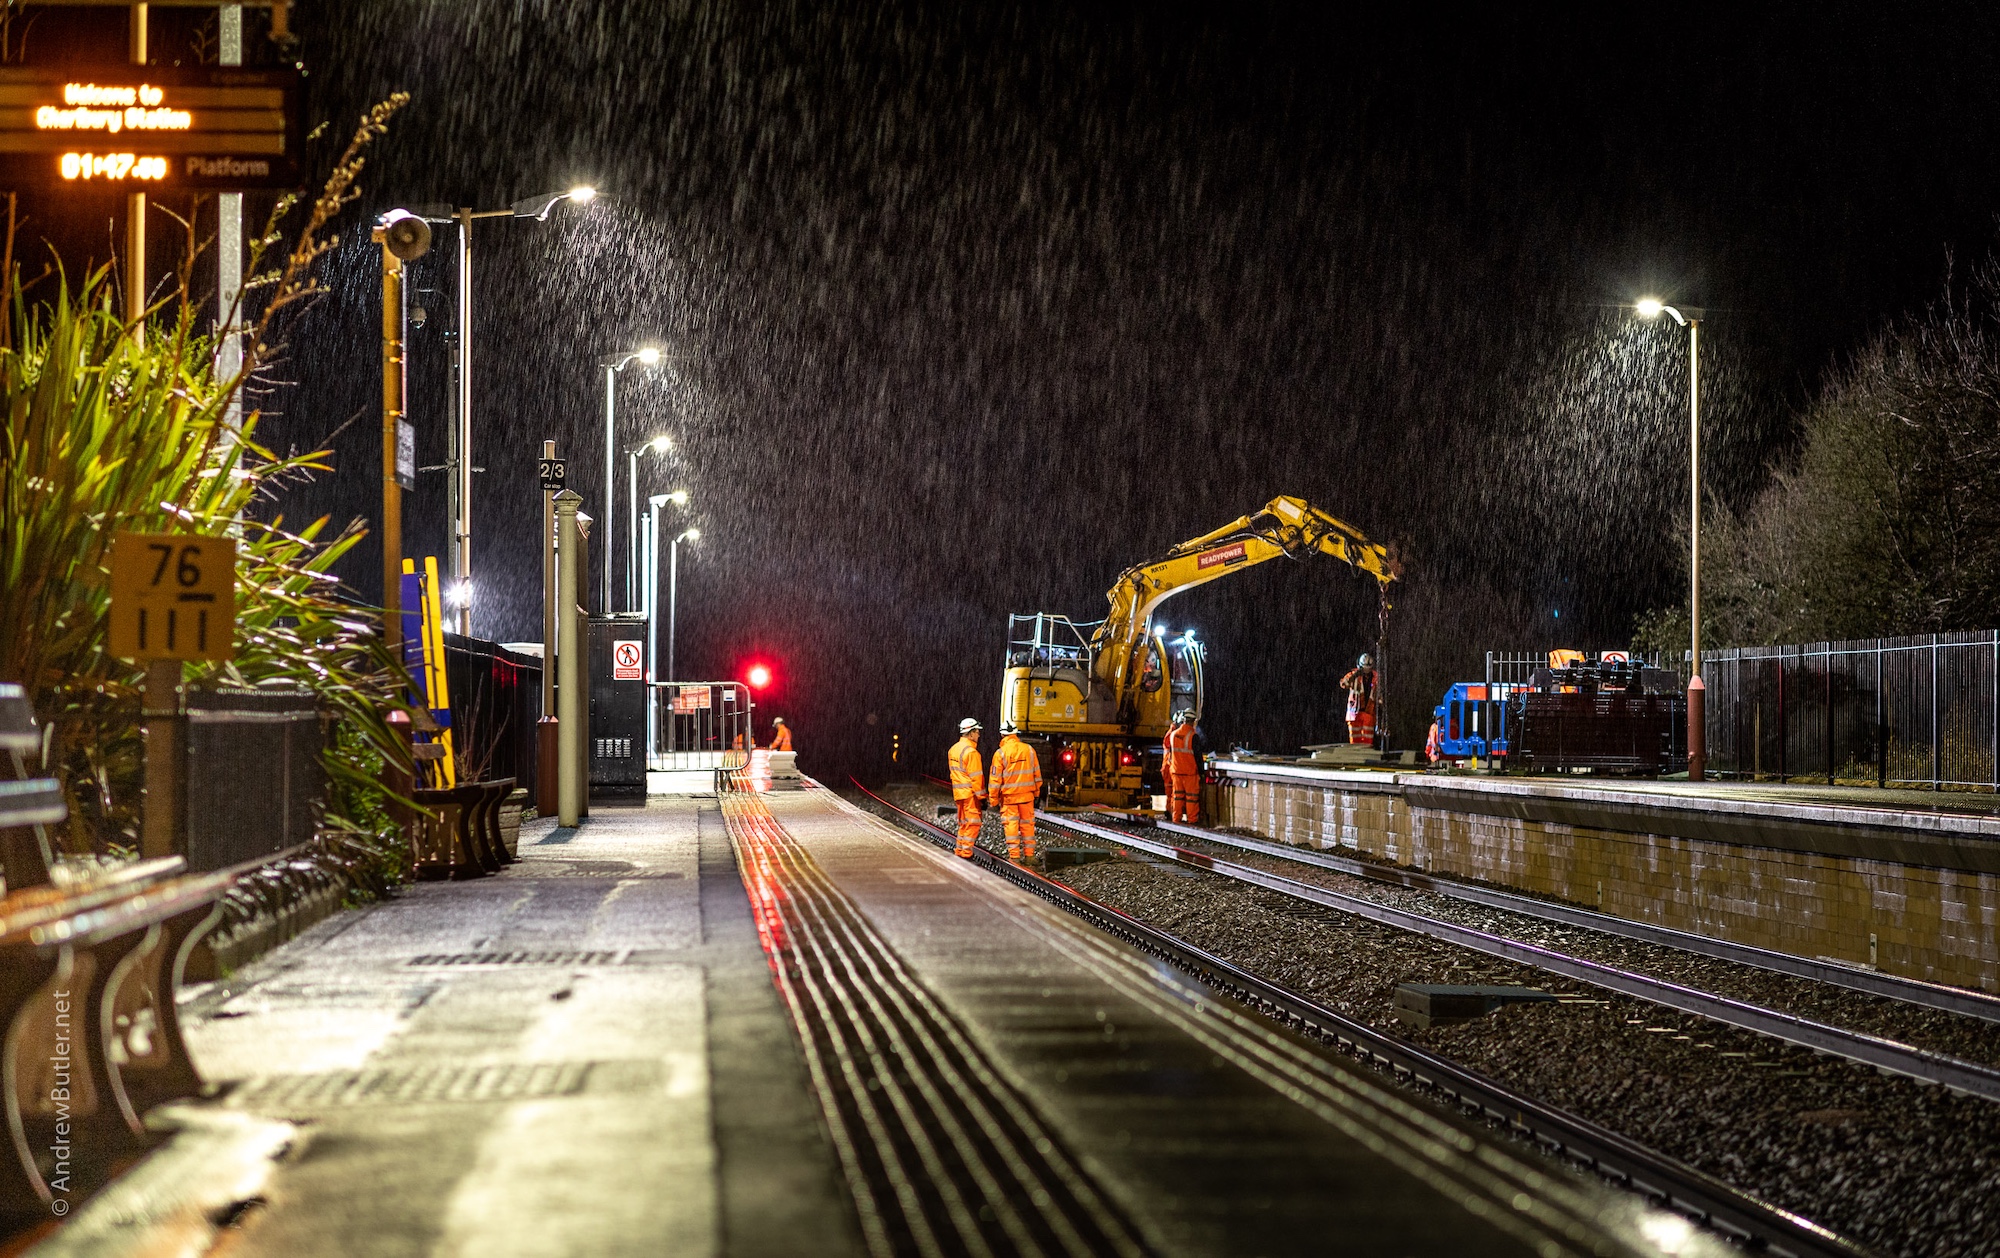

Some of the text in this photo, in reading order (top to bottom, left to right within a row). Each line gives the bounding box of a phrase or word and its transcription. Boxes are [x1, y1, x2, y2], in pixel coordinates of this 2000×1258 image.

[65, 83, 163, 105] Welcome to
[124, 107, 191, 129] Station
[186, 157, 269, 176] Platform
[540, 462, 565, 480] 2/3
[148, 543, 201, 587] 76
[1200, 547, 1243, 565] READYPOWER
